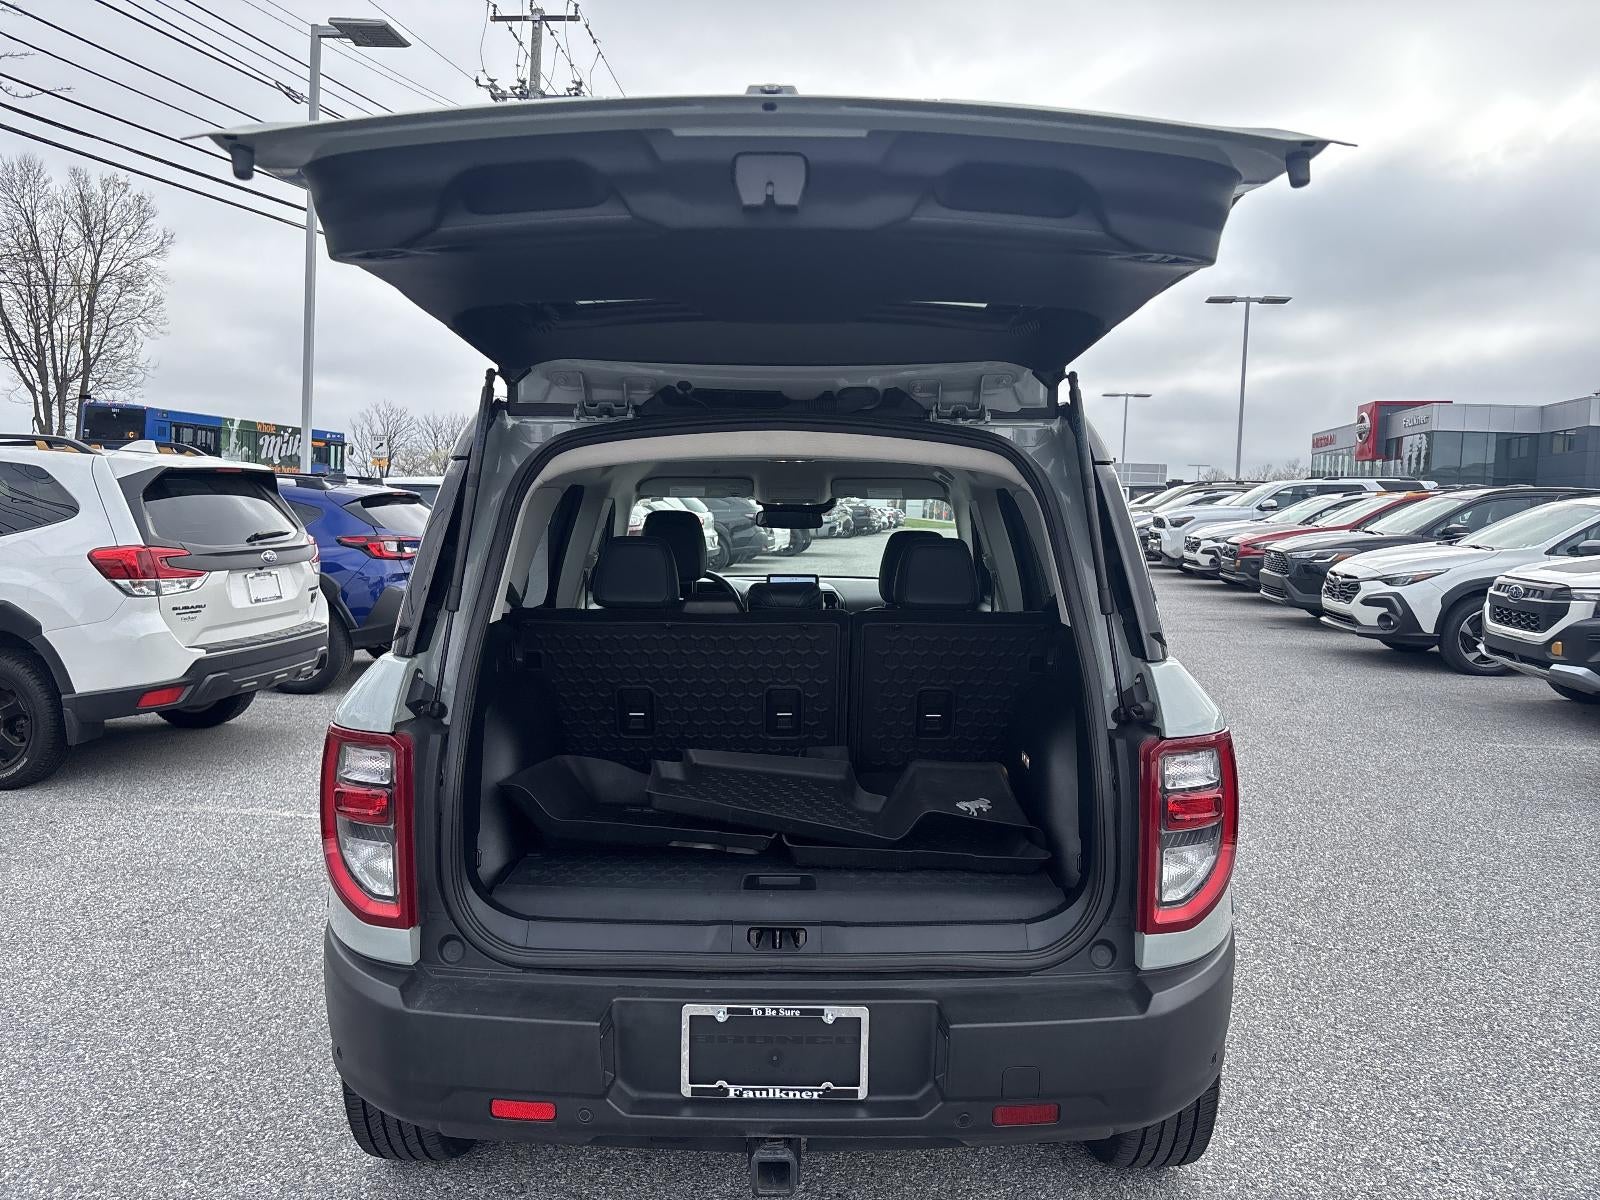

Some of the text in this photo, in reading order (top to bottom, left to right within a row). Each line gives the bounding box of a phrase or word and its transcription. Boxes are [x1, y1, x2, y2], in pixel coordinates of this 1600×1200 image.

[750, 1007, 801, 1016] To Be Sure
[727, 1087, 824, 1099] Faulkner
